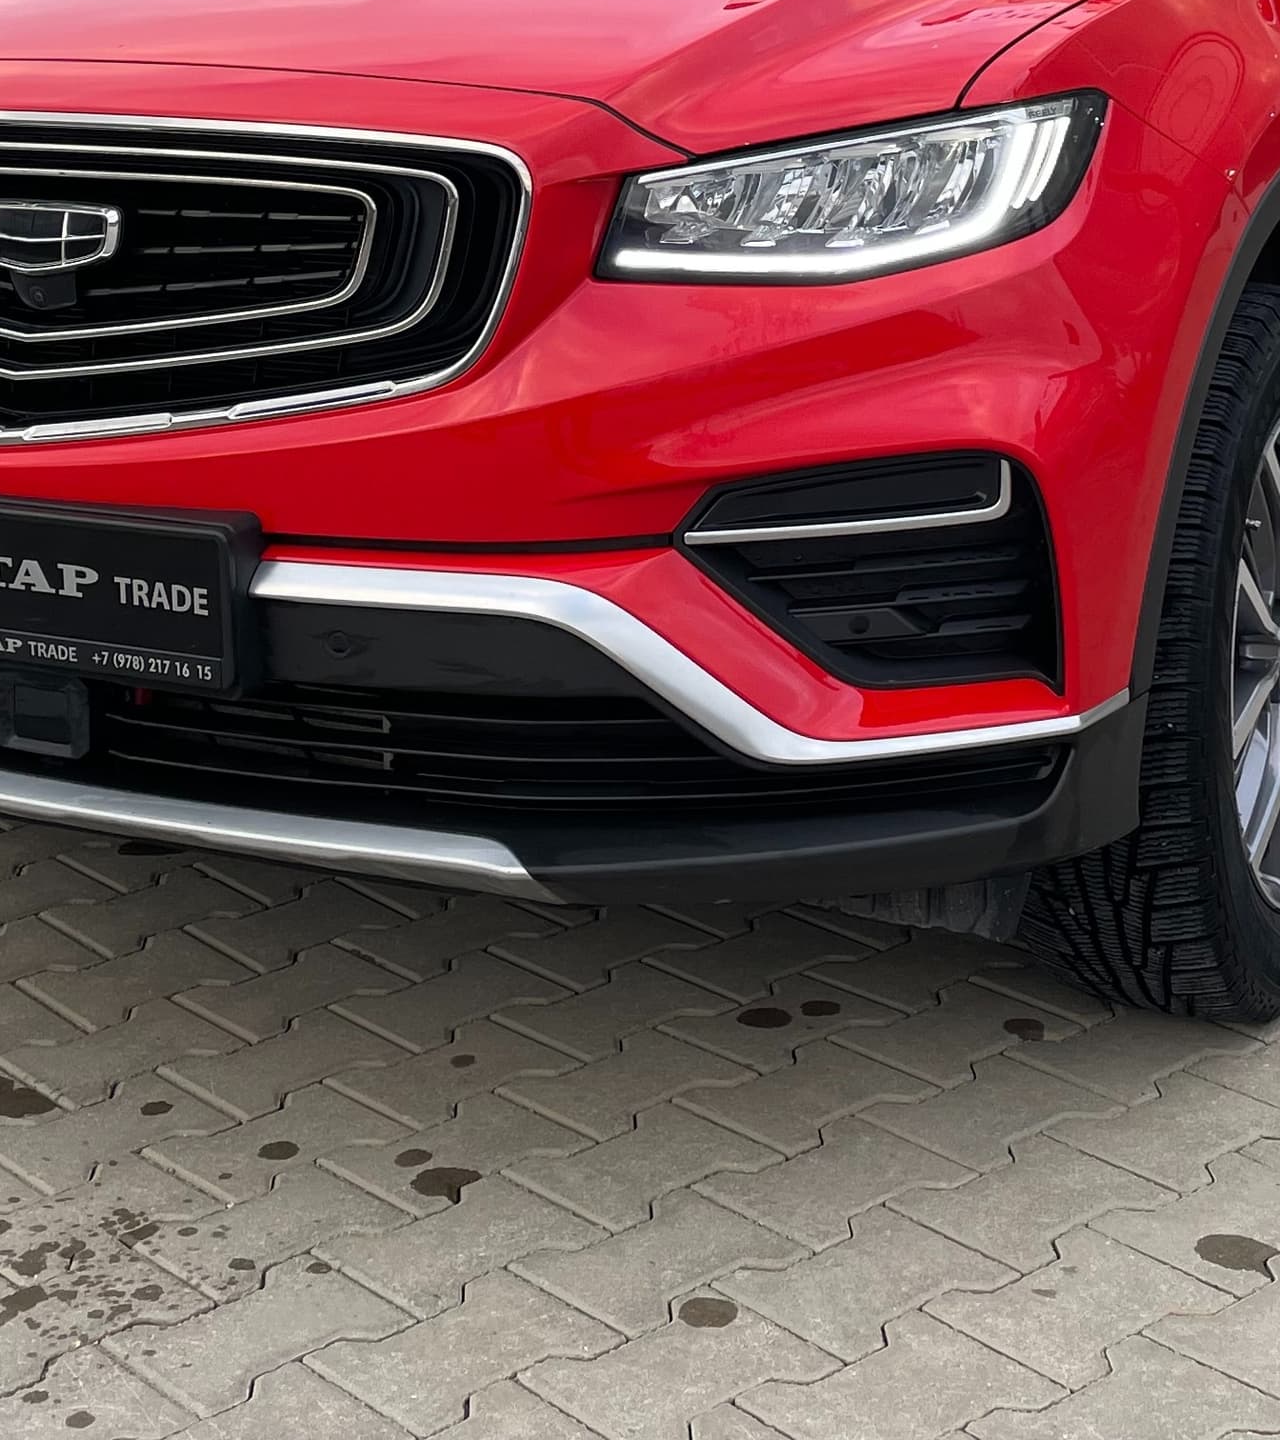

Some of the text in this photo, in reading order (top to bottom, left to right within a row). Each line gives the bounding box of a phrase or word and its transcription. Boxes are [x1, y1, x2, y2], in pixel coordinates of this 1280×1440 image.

[114, 576, 209, 616] TRADE
[27, 640, 78, 662] TRADE
[92, 651, 109, 666] +7
[113, 652, 145, 672] (978)
[148, 657, 170, 674] 217
[175, 661, 190, 678] 16
[197, 664, 212, 680] 15
